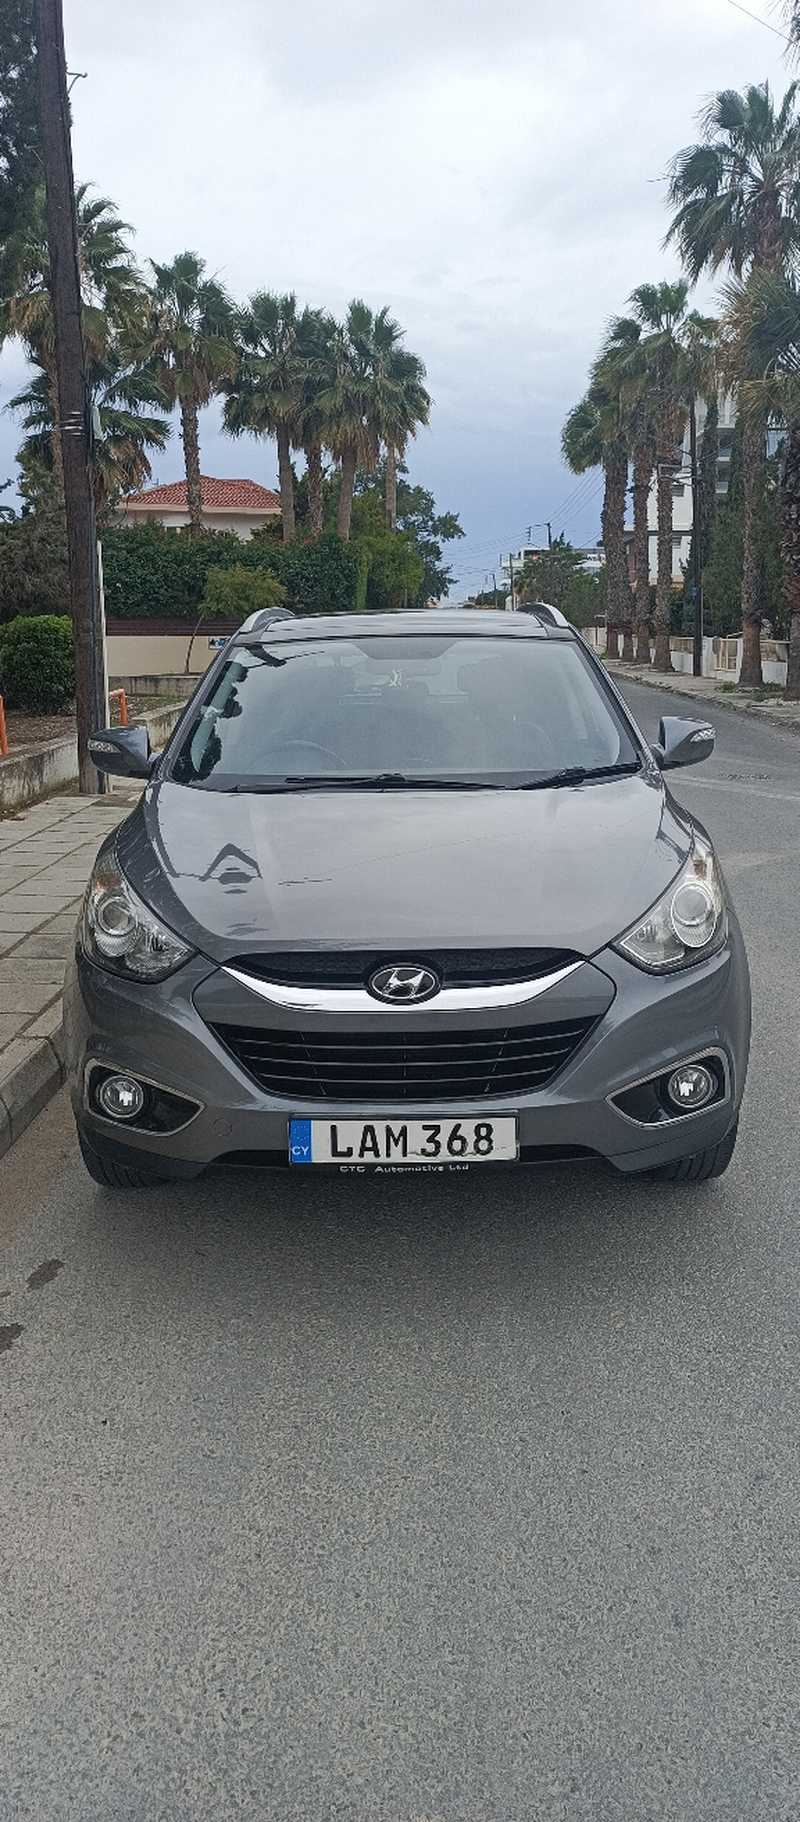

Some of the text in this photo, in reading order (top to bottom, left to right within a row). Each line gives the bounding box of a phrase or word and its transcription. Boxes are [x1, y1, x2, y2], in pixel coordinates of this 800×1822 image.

[330, 1122, 494, 1158] LAM 368
[292, 1146, 310, 1156] CY
[374, 1165, 444, 1173] Automotive
